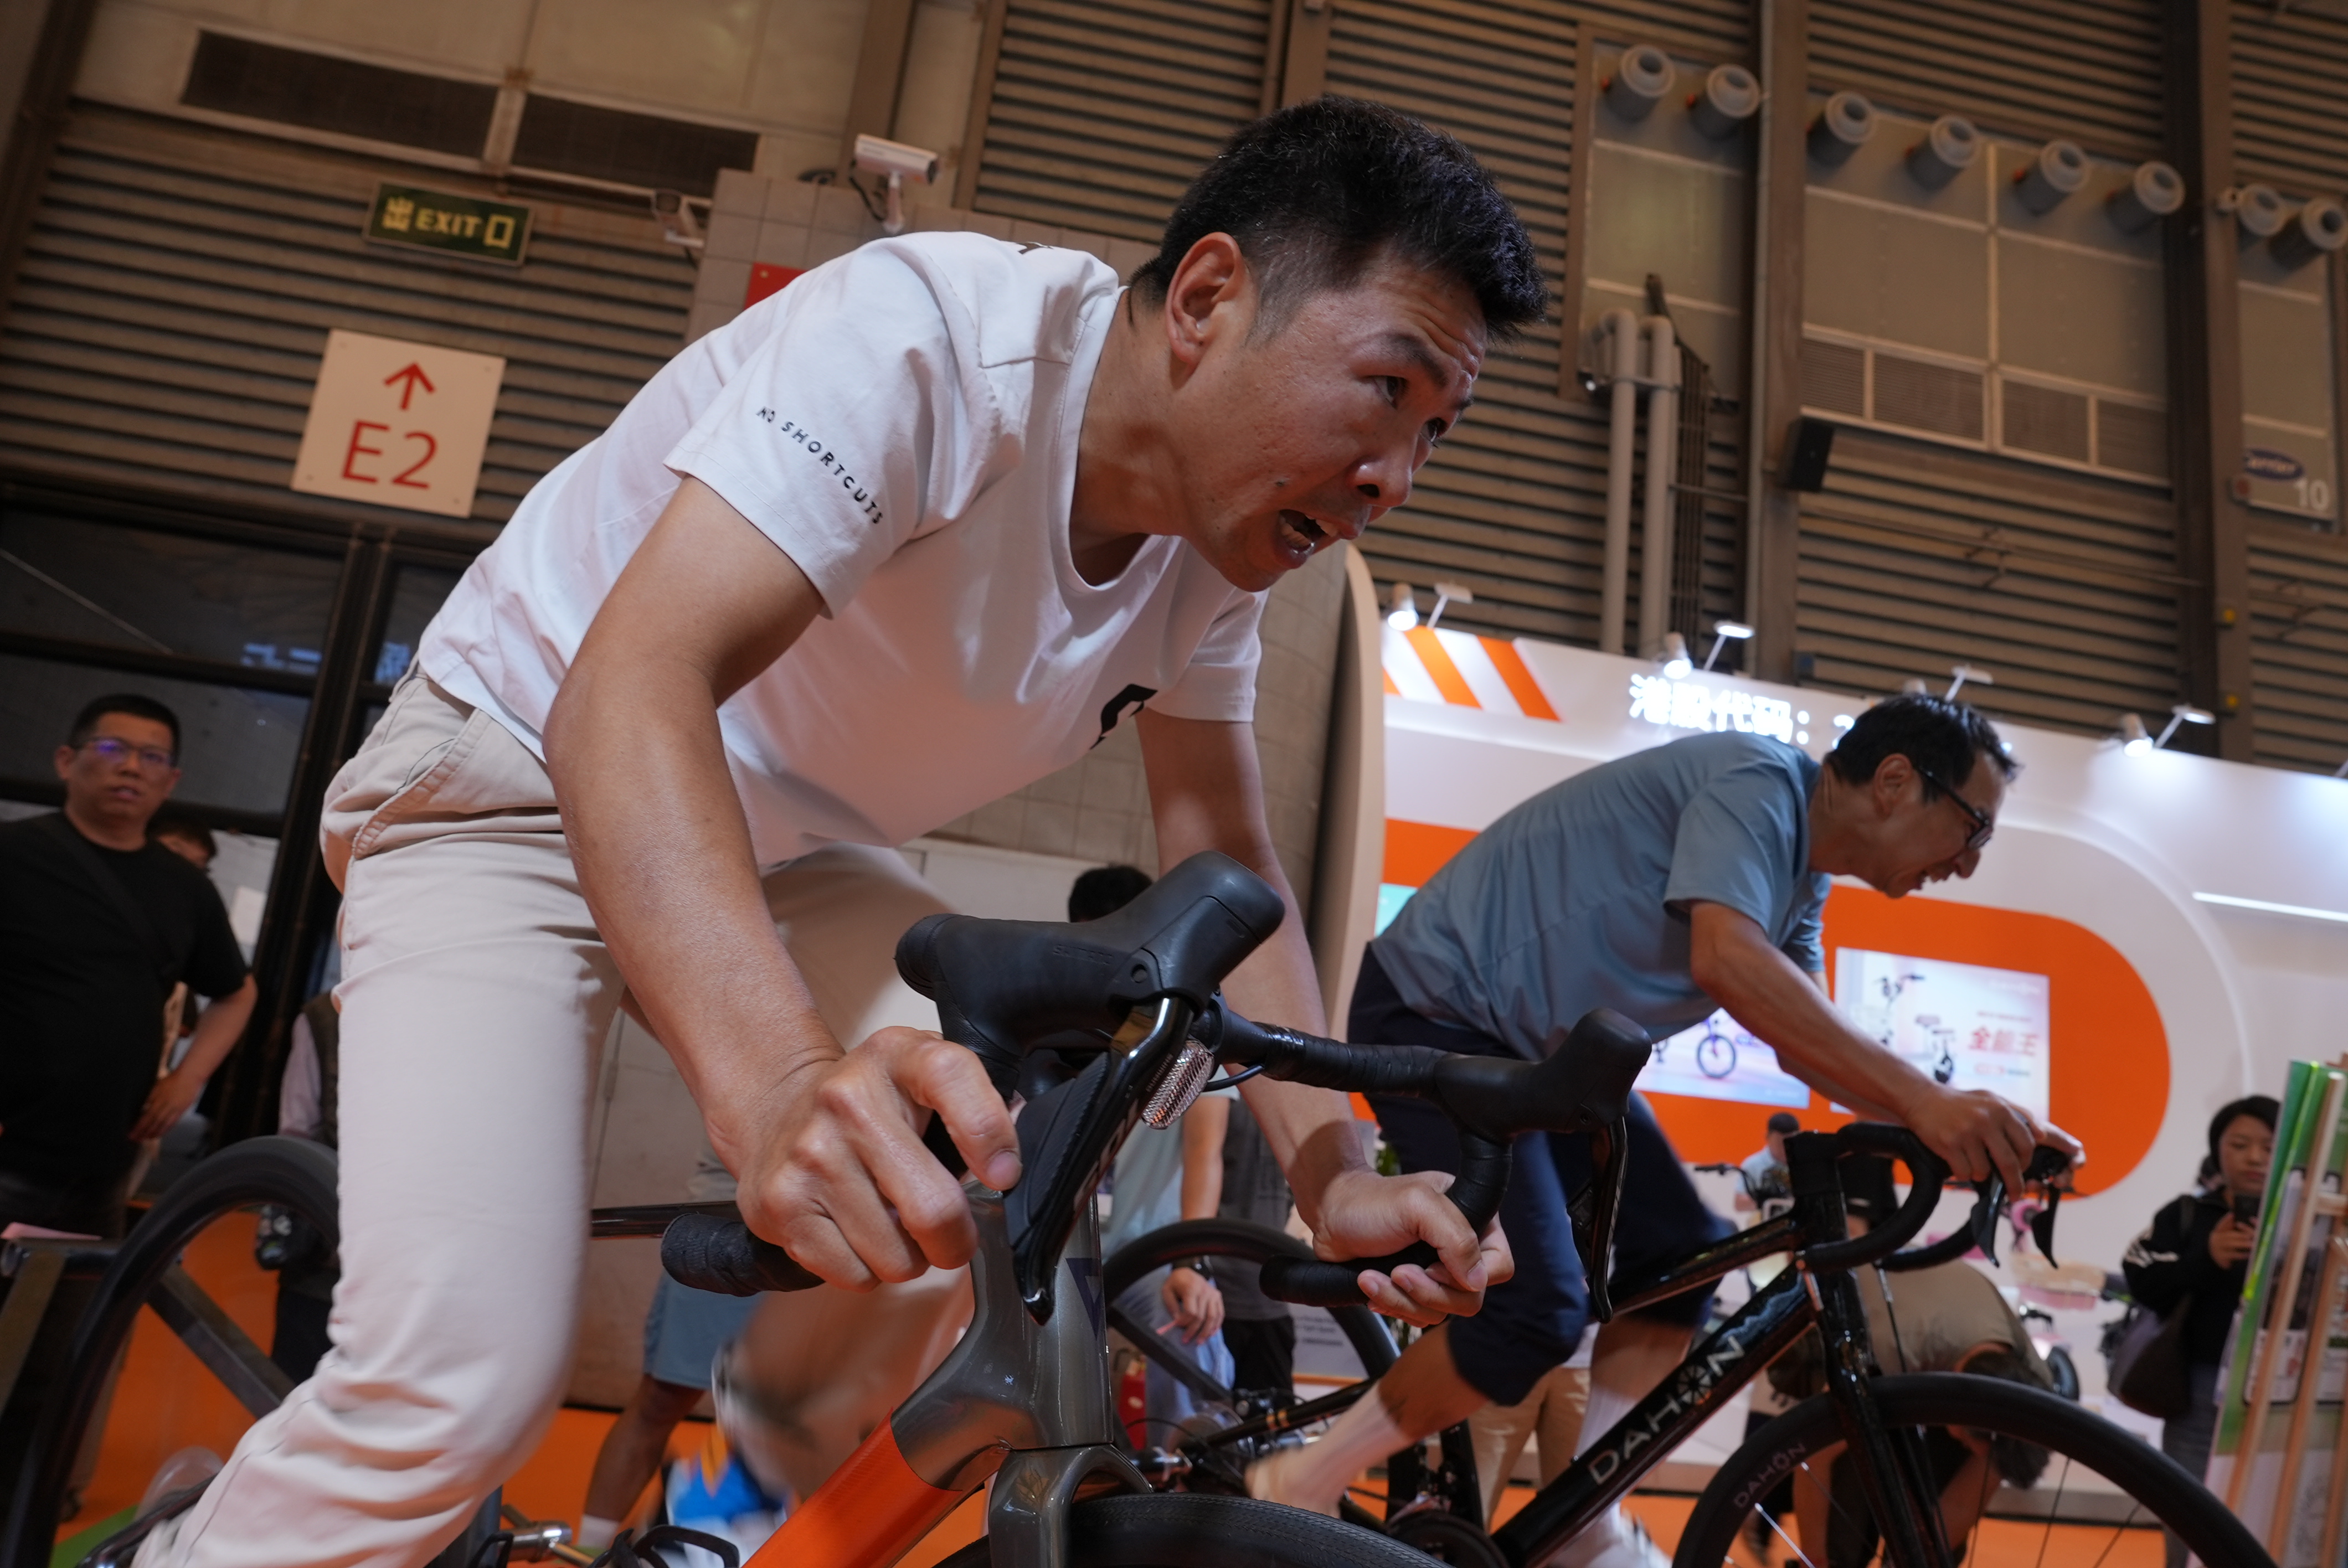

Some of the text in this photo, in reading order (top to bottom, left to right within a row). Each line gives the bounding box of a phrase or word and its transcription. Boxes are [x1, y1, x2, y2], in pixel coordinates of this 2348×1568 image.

[382, 197, 413, 231] 出
[416, 209, 481, 238] EXIT
[341, 420, 438, 489] E2
[781, 421, 883, 525] SHORTCUTS
[2294, 477, 2329, 510] 10
